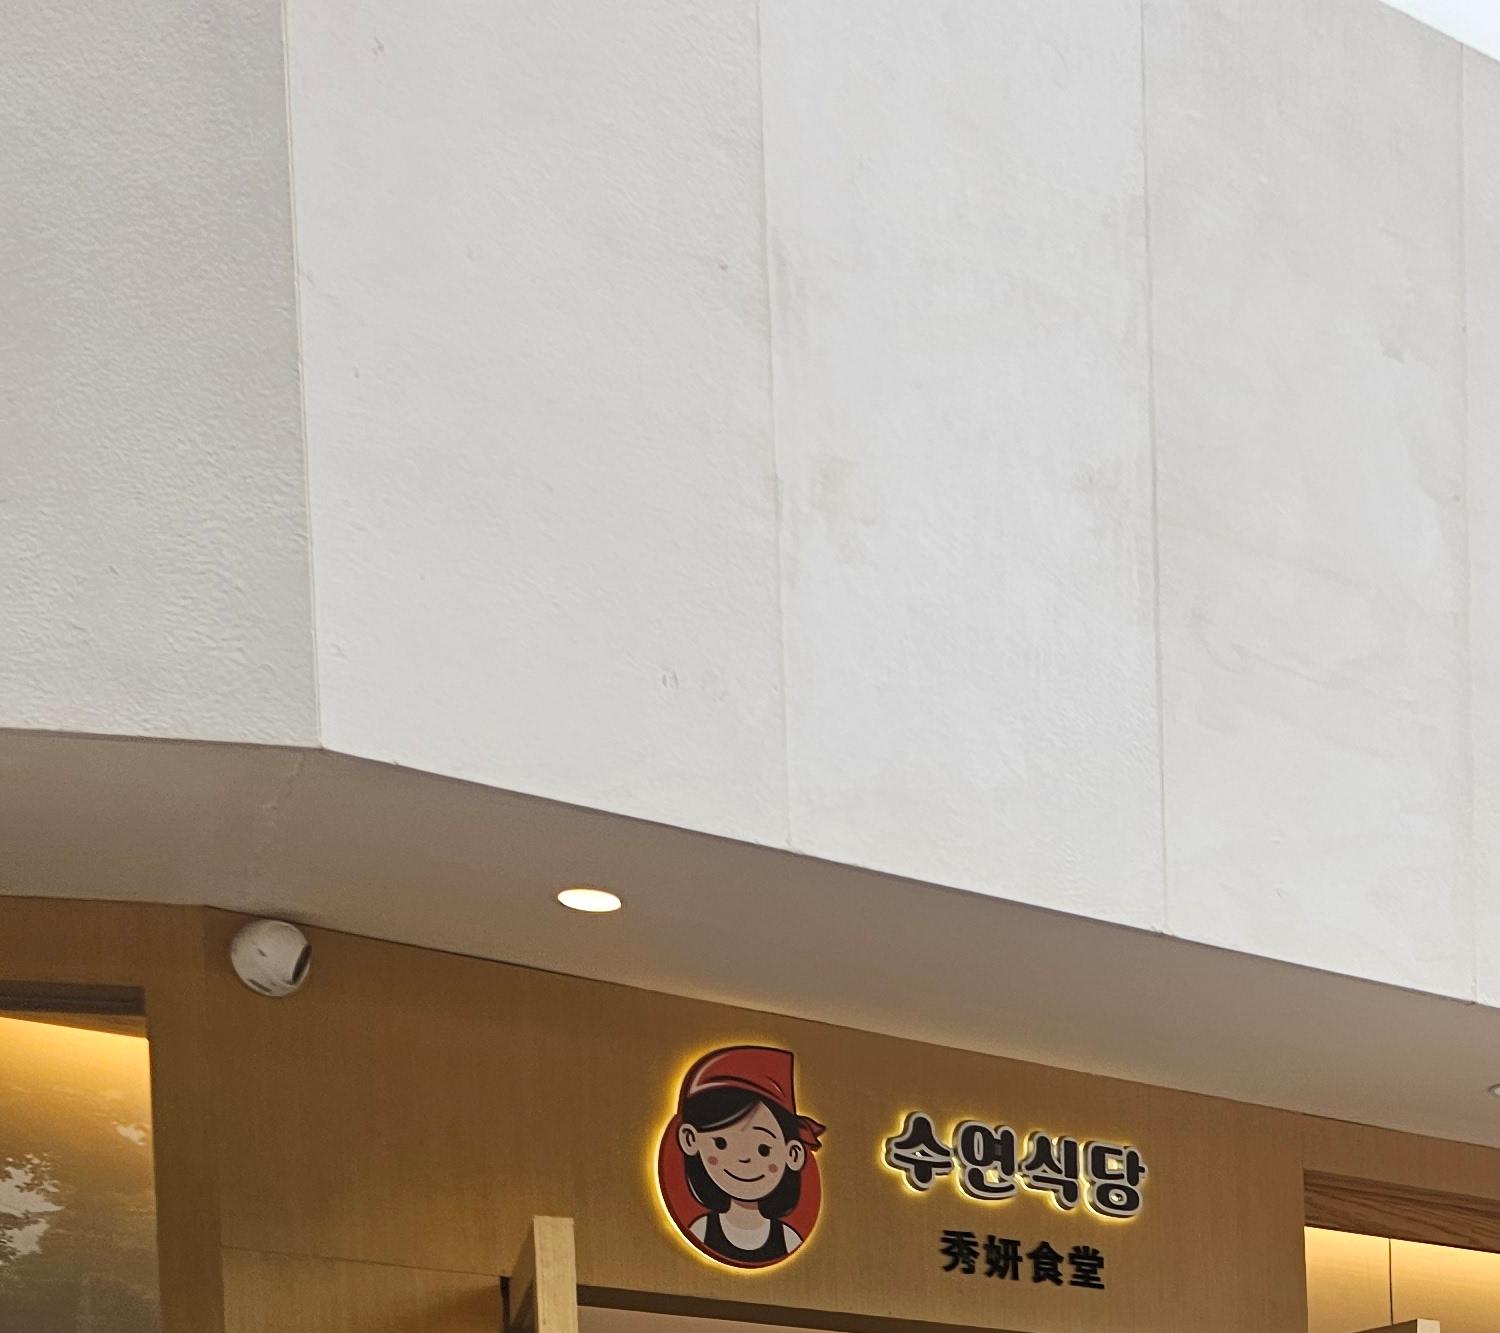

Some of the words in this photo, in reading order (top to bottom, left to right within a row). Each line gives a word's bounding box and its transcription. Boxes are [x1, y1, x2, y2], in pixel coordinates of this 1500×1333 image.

[885, 1111, 1147, 1217] 수연식당
[940, 1229, 1105, 1289] 秀妍食堂
